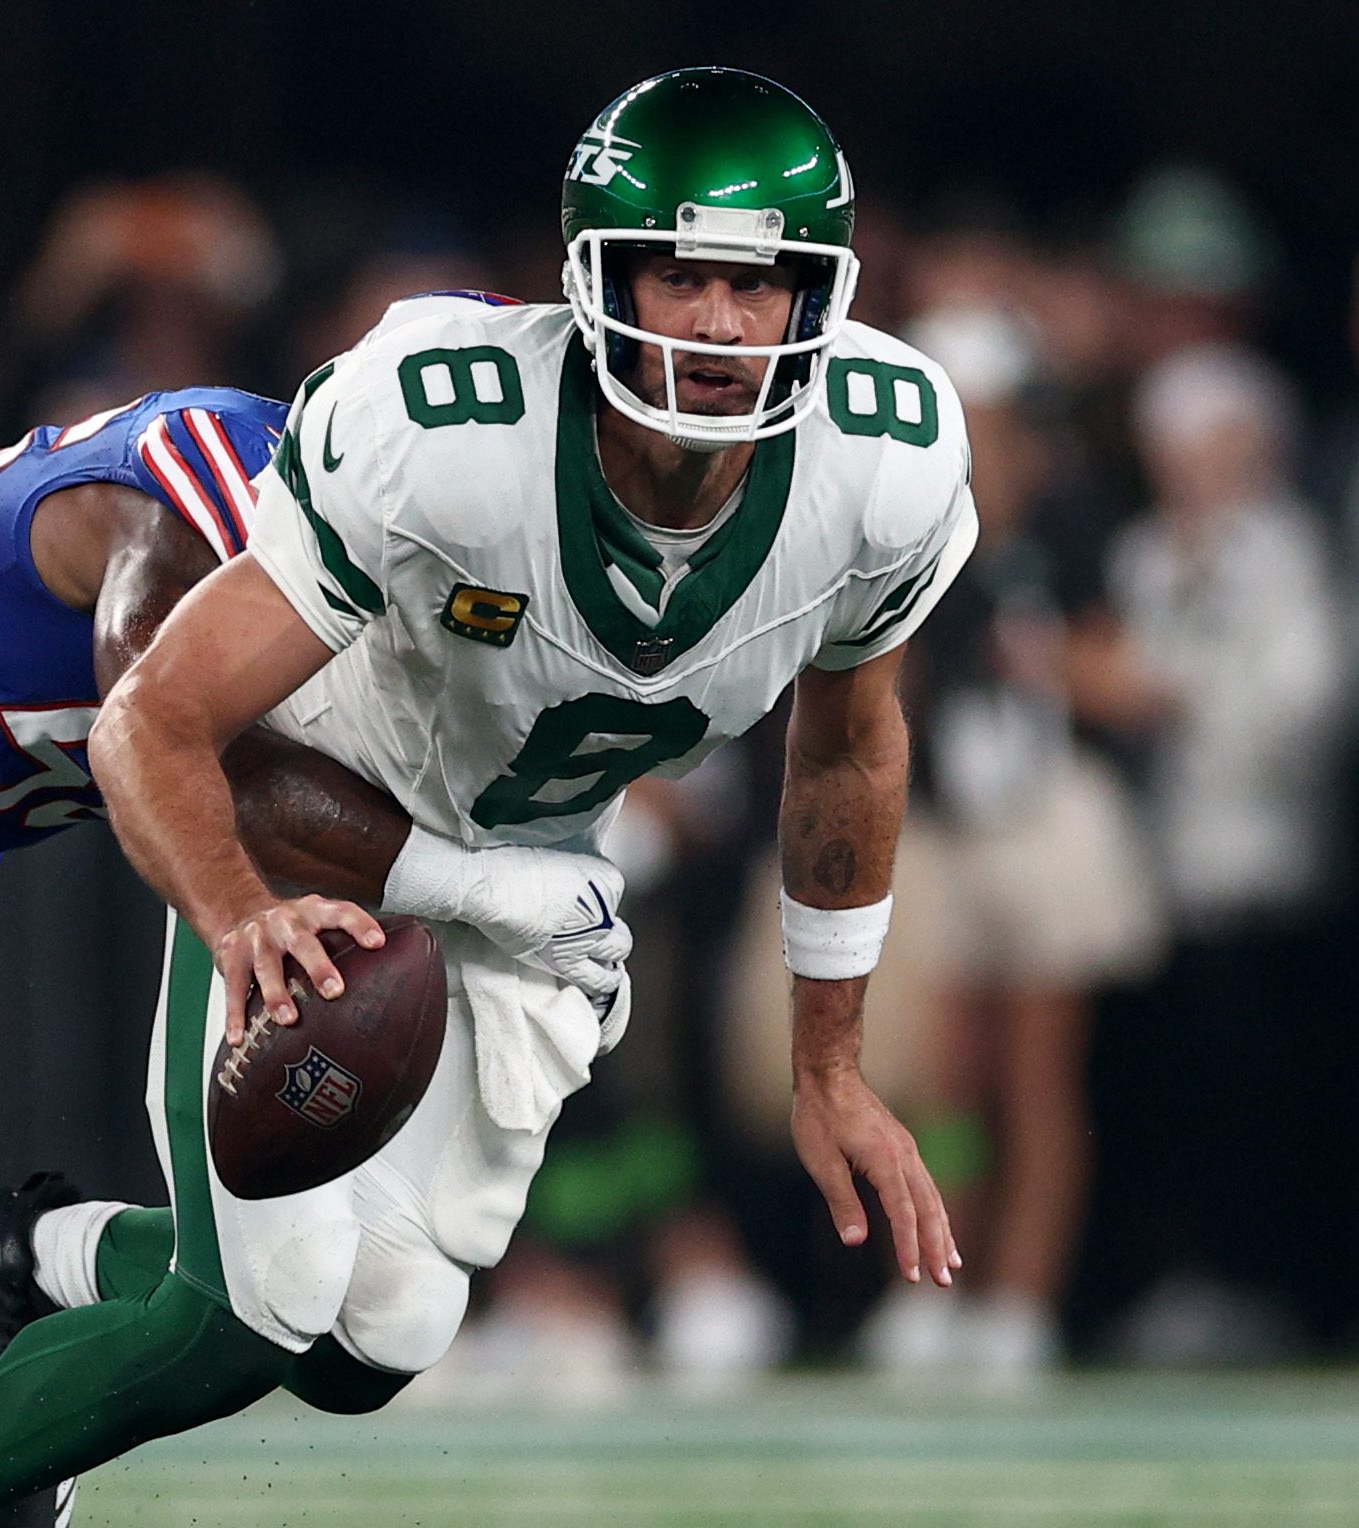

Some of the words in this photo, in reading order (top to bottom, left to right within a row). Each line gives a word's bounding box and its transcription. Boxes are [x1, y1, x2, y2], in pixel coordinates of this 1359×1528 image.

[397, 345, 526, 430] 8
[825, 356, 939, 448] 8
[451, 588, 521, 632] C
[470, 692, 711, 830] 8
[303, 1074, 356, 1124] NFL
